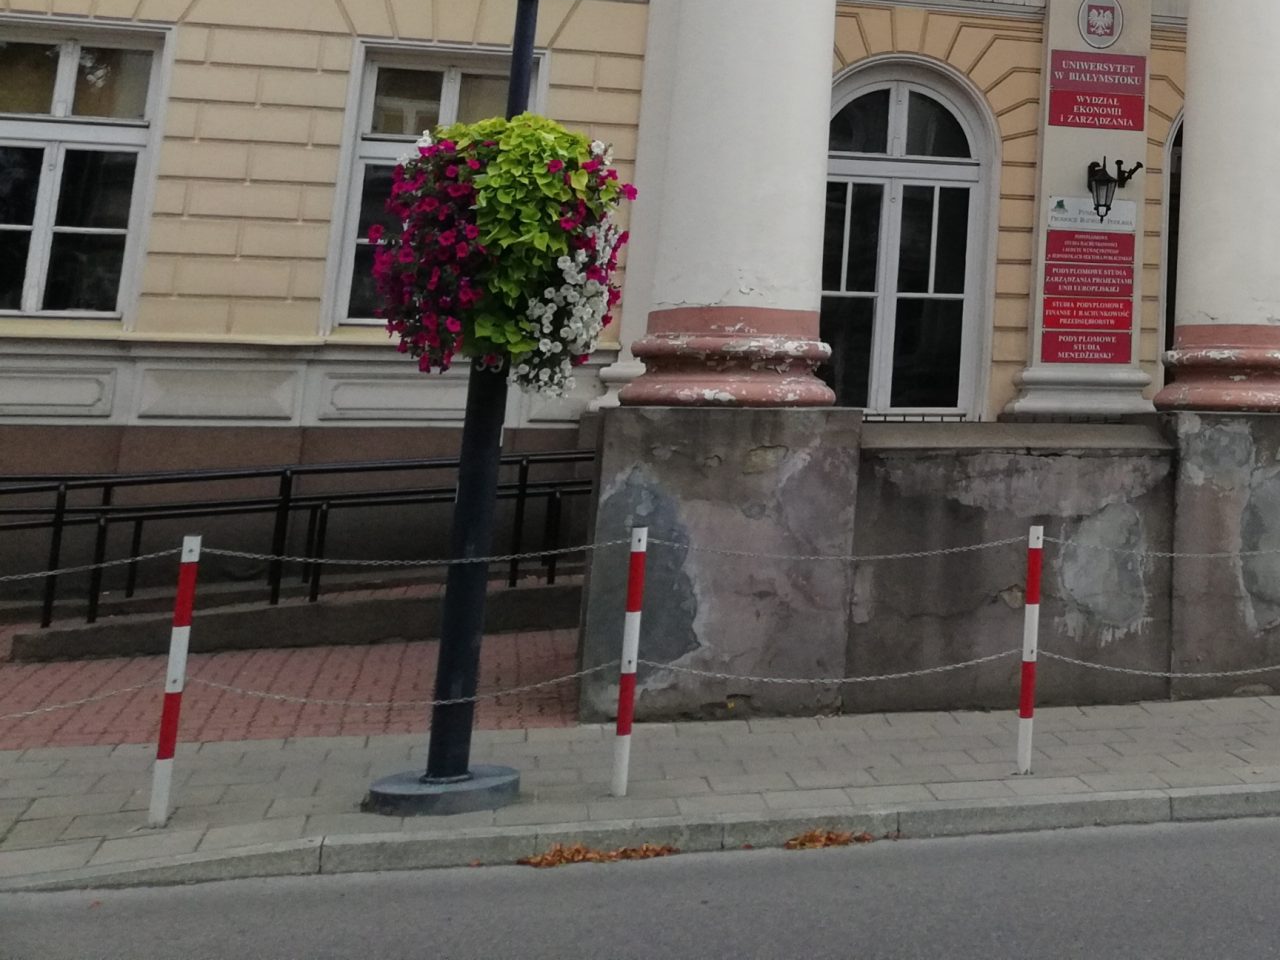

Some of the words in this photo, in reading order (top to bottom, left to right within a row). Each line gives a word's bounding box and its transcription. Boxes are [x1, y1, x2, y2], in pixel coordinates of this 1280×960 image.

[1062, 60, 1136, 73] UNIWERSYTET
[1054, 71, 1064, 79] W
[1076, 95, 1120, 105] WYDZIAŁ
[1073, 105, 1122, 115] EKONOMII
[1067, 115, 1134, 126] ZARZĄDZANIA
[1058, 335, 1117, 343] PODYPLOMOWE
